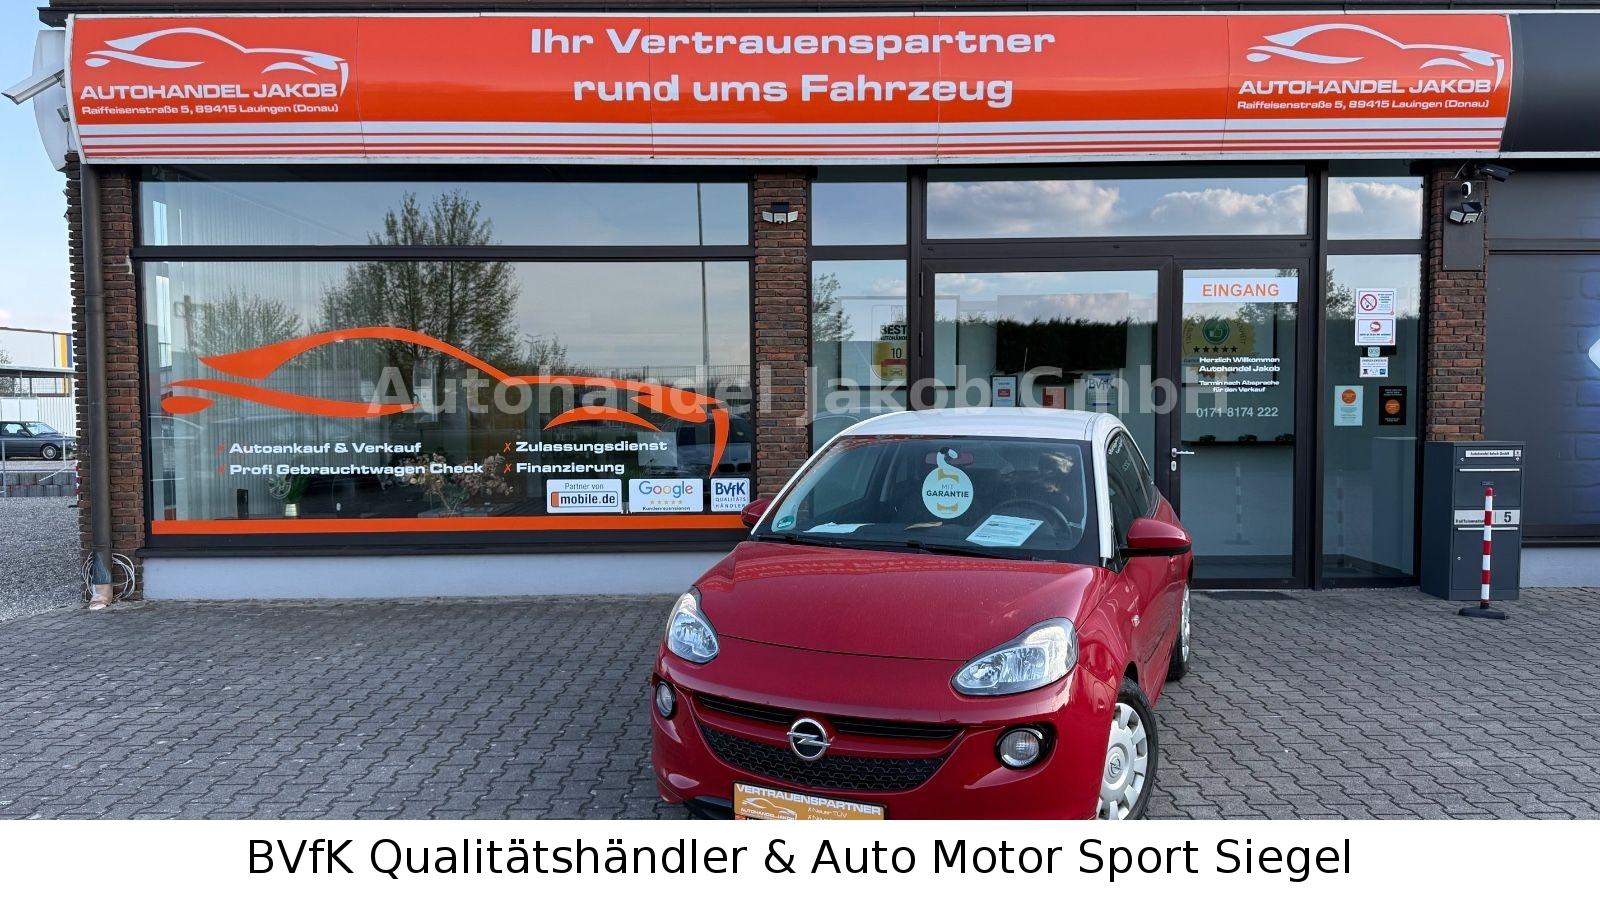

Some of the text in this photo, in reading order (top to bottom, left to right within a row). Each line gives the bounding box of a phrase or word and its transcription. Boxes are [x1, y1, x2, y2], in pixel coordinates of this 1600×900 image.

[531, 28, 1056, 60] Ihr Vertrauenspartner
[80, 83, 337, 101] AUTOHANDEL JAKOB
[574, 74, 1013, 109] rund ums Fahrzeug
[1238, 79, 1491, 95] AUTOHANDEL JAKOB
[82, 103, 339, 115] Raiffeisenstraße 5, 89415 Lauingen (Donau)
[1237, 99, 1490, 111] Raiffeisenstraße 5, 89415 Lauingen (Donau)
[1202, 283, 1279, 297] EINGANG
[891, 347, 902, 359] 10
[1196, 407, 1279, 418] 0171 8174 222
[229, 442, 422, 454] Autoankauf & Verkauf
[516, 441, 668, 454] Zulassungsdienst
[230, 463, 484, 477] Profi Gebrauchtwagen Check
[516, 463, 625, 475] Finanzierung
[564, 482, 591, 490] Partner
[639, 481, 693, 498] Google
[560, 494, 616, 505] mobile.de
[926, 490, 969, 498] GARANTIE
[1503, 512, 1512, 523] 5
[735, 783, 881, 815] VERTRAUENSPARTNER
